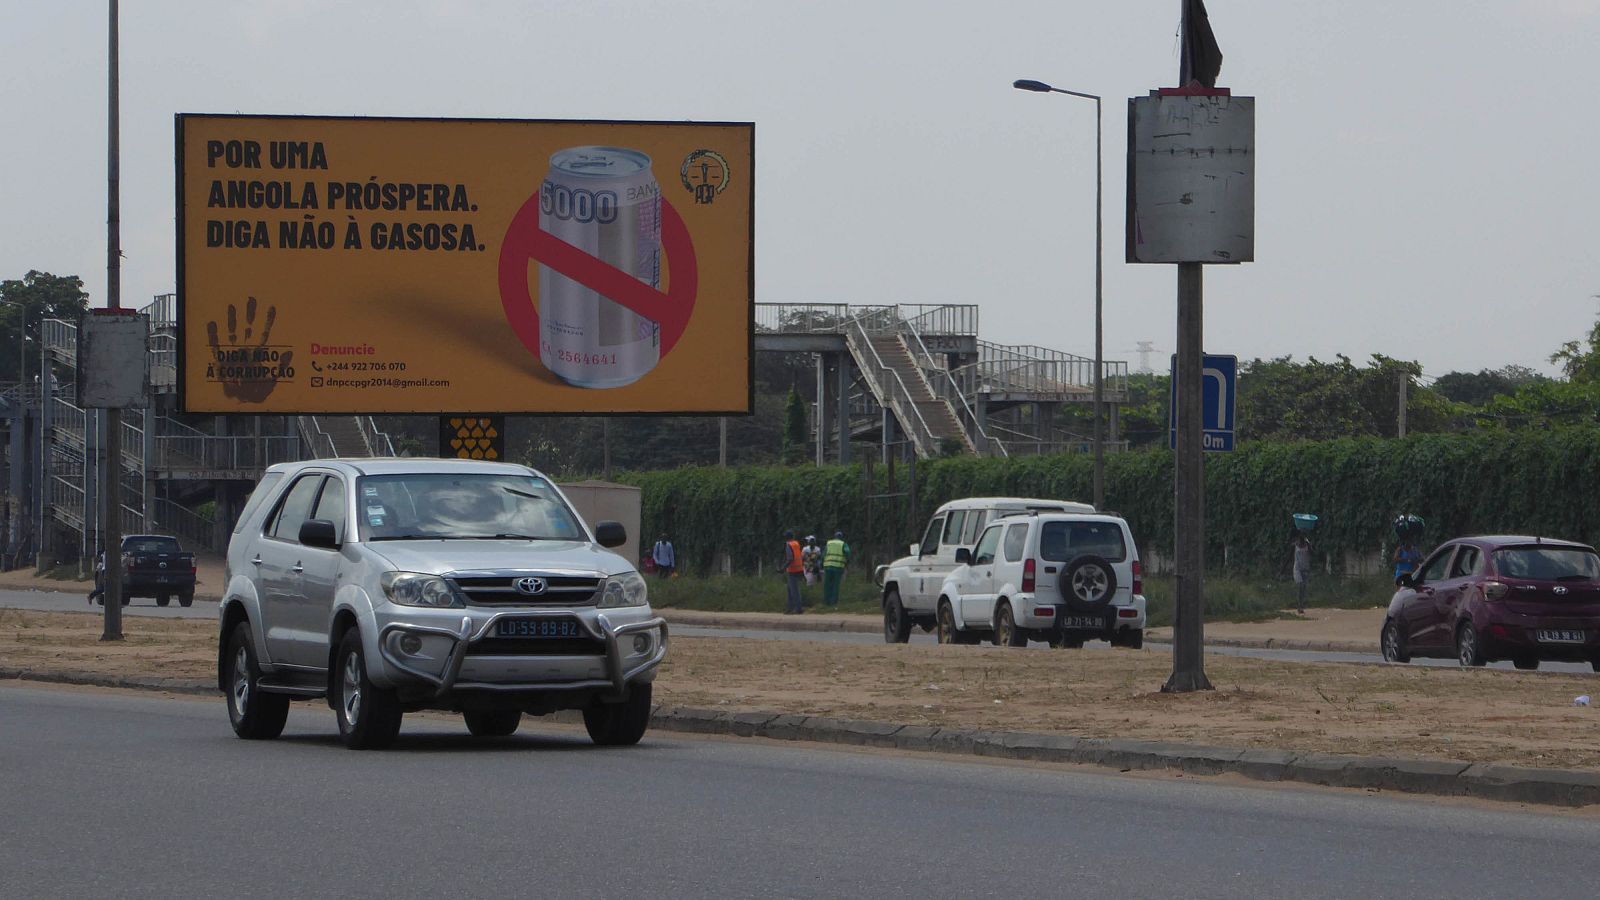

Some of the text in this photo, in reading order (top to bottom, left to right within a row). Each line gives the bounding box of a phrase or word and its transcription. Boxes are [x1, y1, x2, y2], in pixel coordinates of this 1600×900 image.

[208, 140, 329, 170] POR UMA
[208, 175, 478, 212] ANGOLA PRÓSPERA.
[541, 181, 618, 224] 5000
[207, 214, 486, 252] DIGA NÃO À GASOSA.
[217, 347, 279, 363] DIGA NÃO
[311, 343, 376, 356] Denuncie
[557, 348, 618, 367] 2564641
[206, 363, 295, 381] À CORRUPÇÃO
[326, 361, 407, 372] +244 922 706 070
[326, 377, 450, 389] dnpccpgr2014@gmail.com
